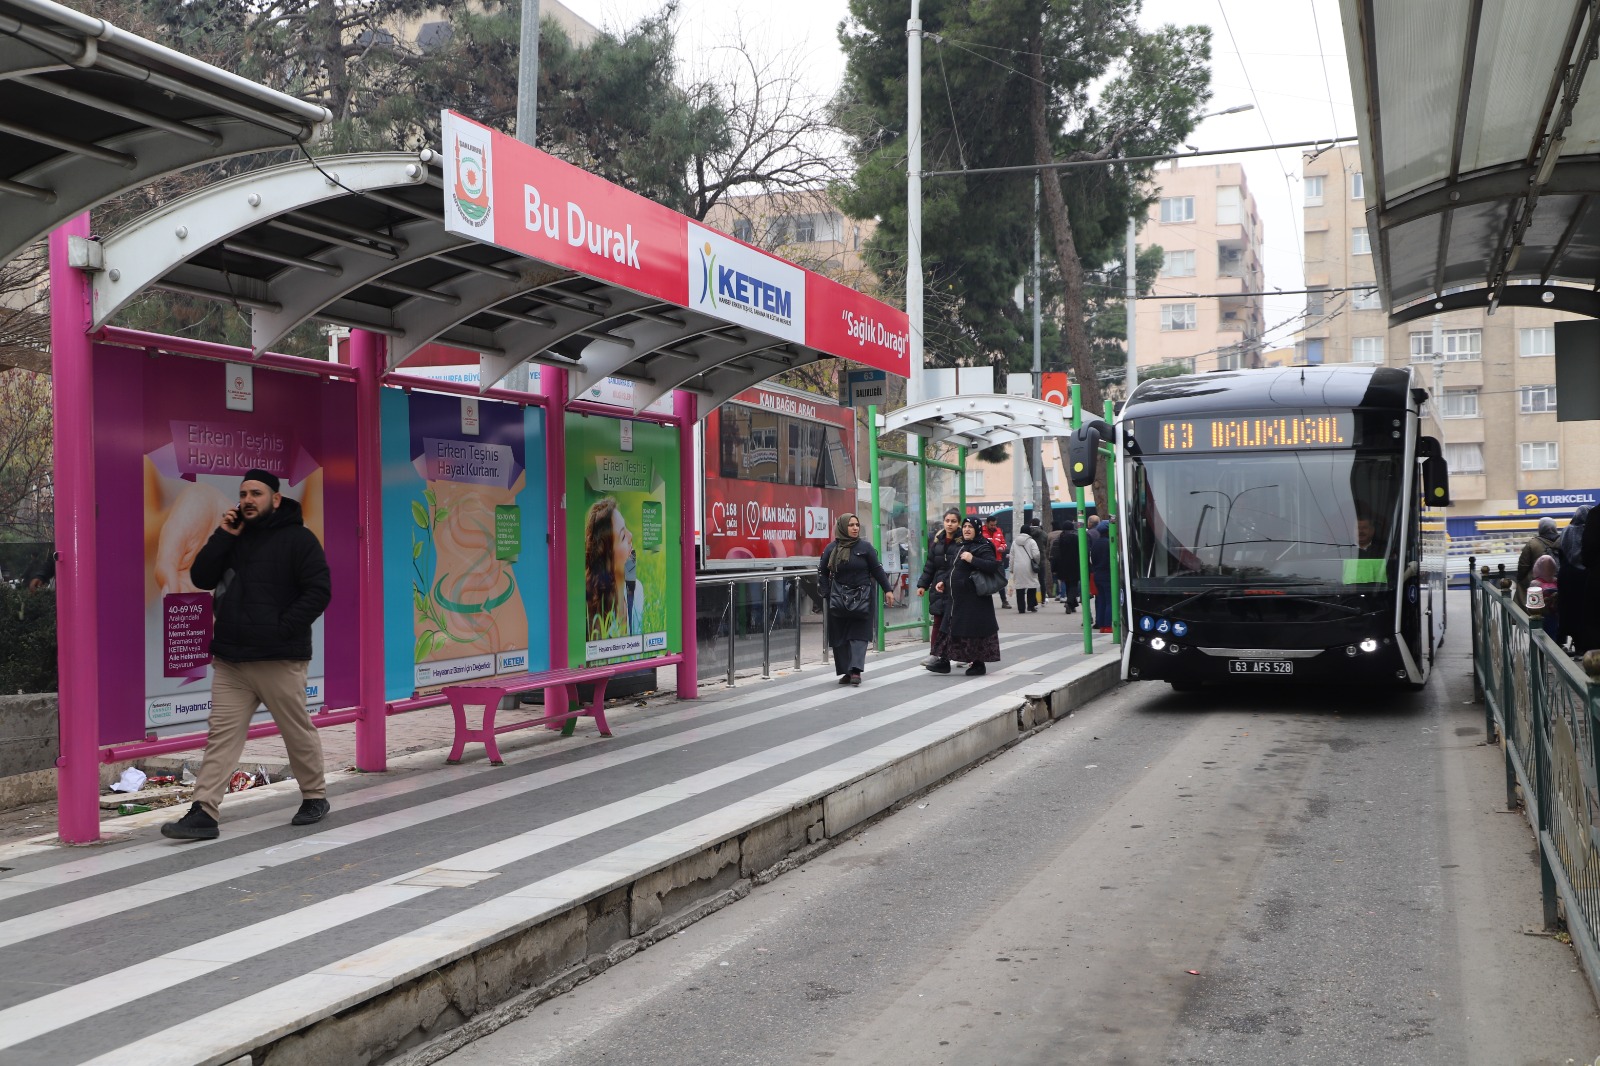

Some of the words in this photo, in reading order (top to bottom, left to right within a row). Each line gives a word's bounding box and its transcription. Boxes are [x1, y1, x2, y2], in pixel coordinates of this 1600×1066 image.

[524, 183, 560, 241] Bu
[567, 201, 641, 270] Durak
[718, 264, 792, 319] KETEM
[863, 371, 874, 381] 63
[759, 391, 775, 408] KAN
[797, 402, 816, 419] ARACI
[187, 423, 233, 447] Erken
[237, 429, 284, 454] Teşhis
[1163, 423, 1193, 449] 63
[188, 447, 230, 471] Hayat
[234, 451, 284, 472] Kurtarır.
[437, 442, 467, 460] Erken
[468, 444, 499, 465] Teşhis
[438, 460, 465, 479] Hayat
[466, 462, 500, 479] Kurtarır.
[603, 457, 624, 472] Erken
[624, 459, 647, 474] Teşhis
[603, 473, 622, 489] Hayat
[1539, 493, 1596, 504] TURKCELL
[725, 502, 737, 517] 168
[762, 506, 776, 523] KAN
[777, 502, 797, 527] BAĞIŞI
[168, 605, 189, 614] 40-69
[189, 604, 203, 614] YAŞ
[168, 630, 186, 638] Meme
[186, 629, 206, 637] Kanseri
[648, 636, 664, 646] KETEM
[168, 638, 193, 646] Taraması
[168, 653, 180, 662] Aile
[503, 656, 525, 667] KETEM
[1235, 661, 1247, 672] 63
[1253, 661, 1271, 672] AFS
[1273, 662, 1291, 673] 528
[175, 701, 207, 715] Hayatınız
